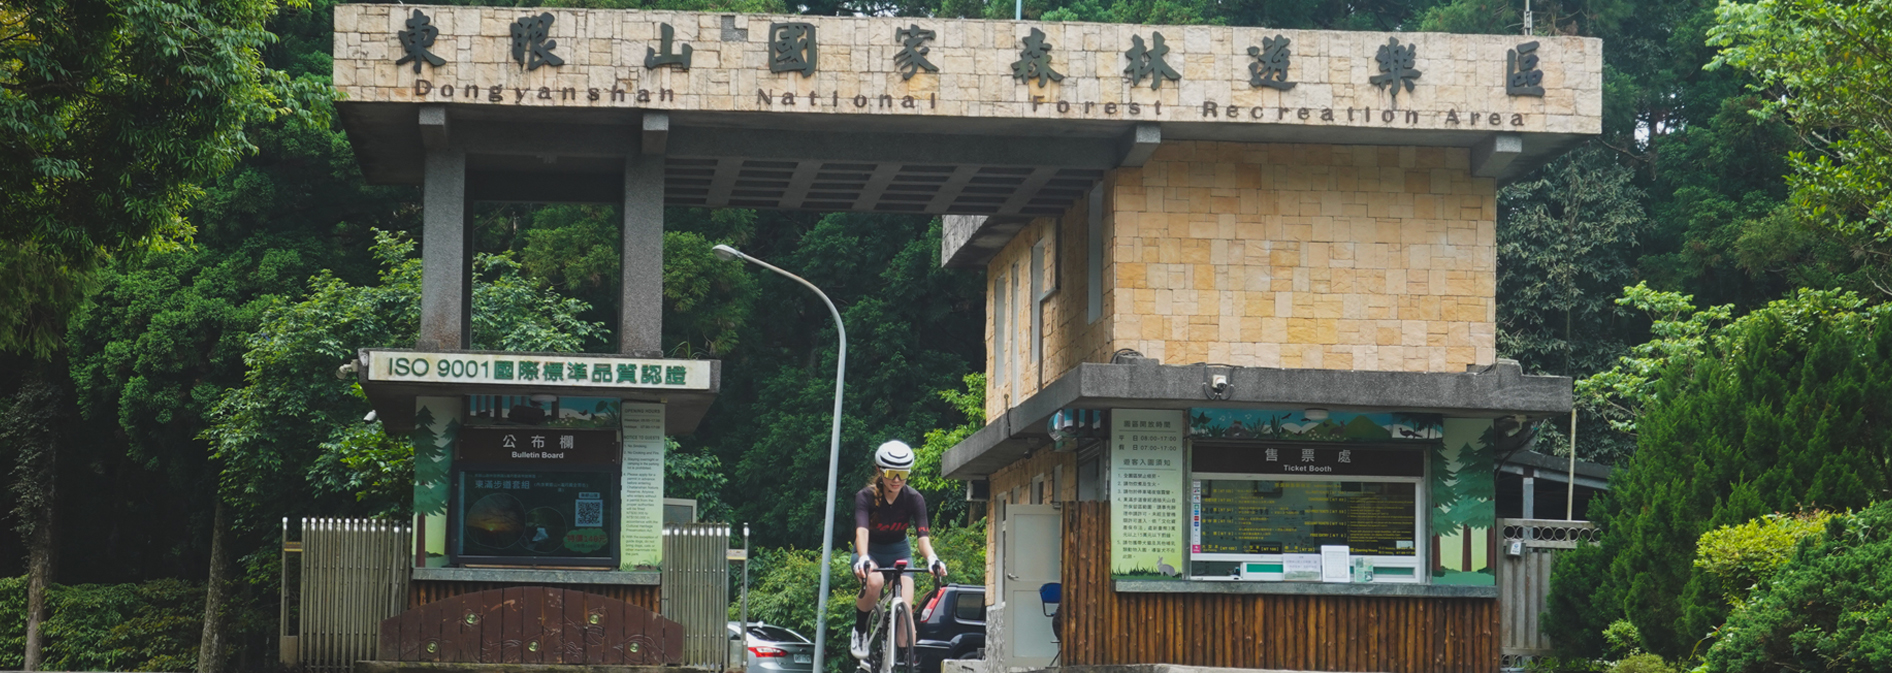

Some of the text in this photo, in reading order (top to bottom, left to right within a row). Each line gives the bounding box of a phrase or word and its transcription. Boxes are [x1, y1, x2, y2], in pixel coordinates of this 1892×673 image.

[396, 8, 1545, 98] 東眼山國家森林遊樂區
[414, 79, 1527, 127] Dongyanshan National Forest Recreation Area
[388, 357, 430, 377] ISO
[502, 434, 574, 449] 公布欄
[541, 451, 564, 459] Board
[1264, 448, 1352, 463] 售票處
[1283, 464, 1332, 472] Ticket Booth
